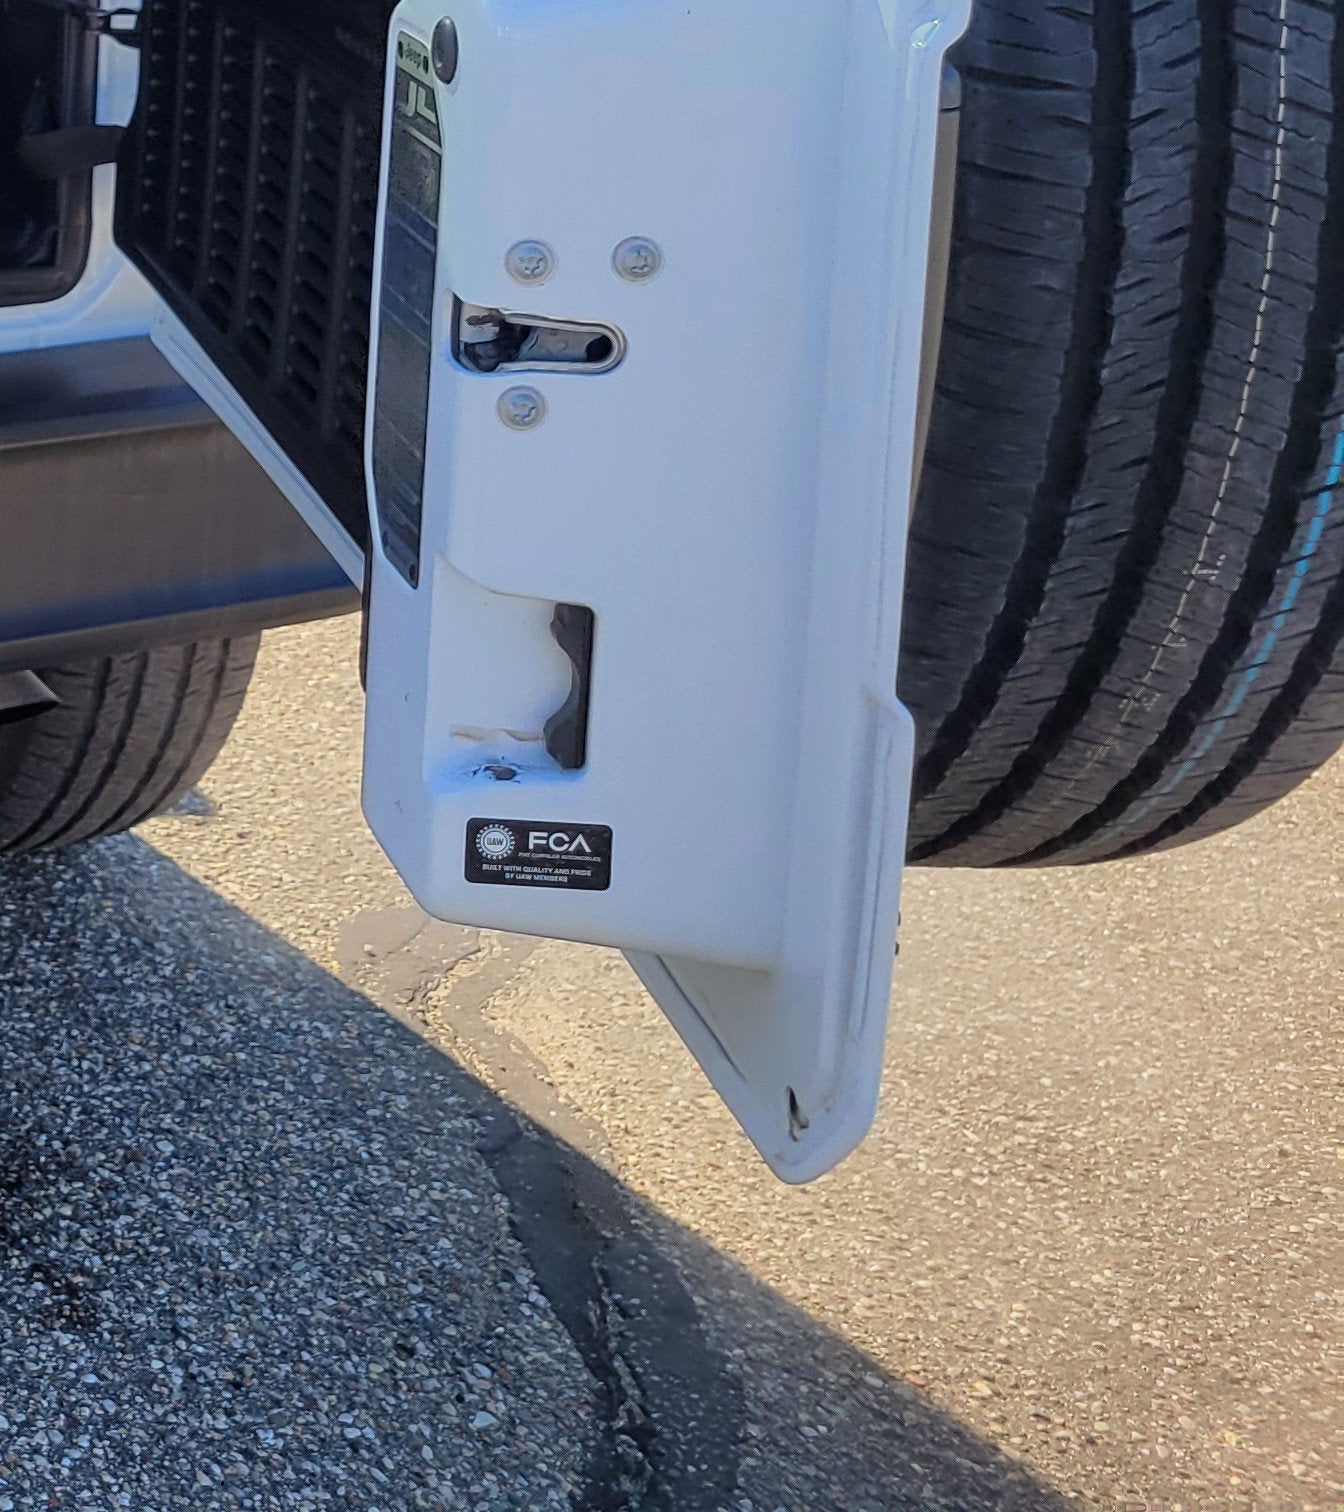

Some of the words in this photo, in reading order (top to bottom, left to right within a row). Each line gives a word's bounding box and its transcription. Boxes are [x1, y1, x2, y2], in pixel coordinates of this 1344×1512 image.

[528, 831, 592, 853] FCA
[482, 863, 502, 871] BUILT
[523, 866, 553, 874] QUALITY
